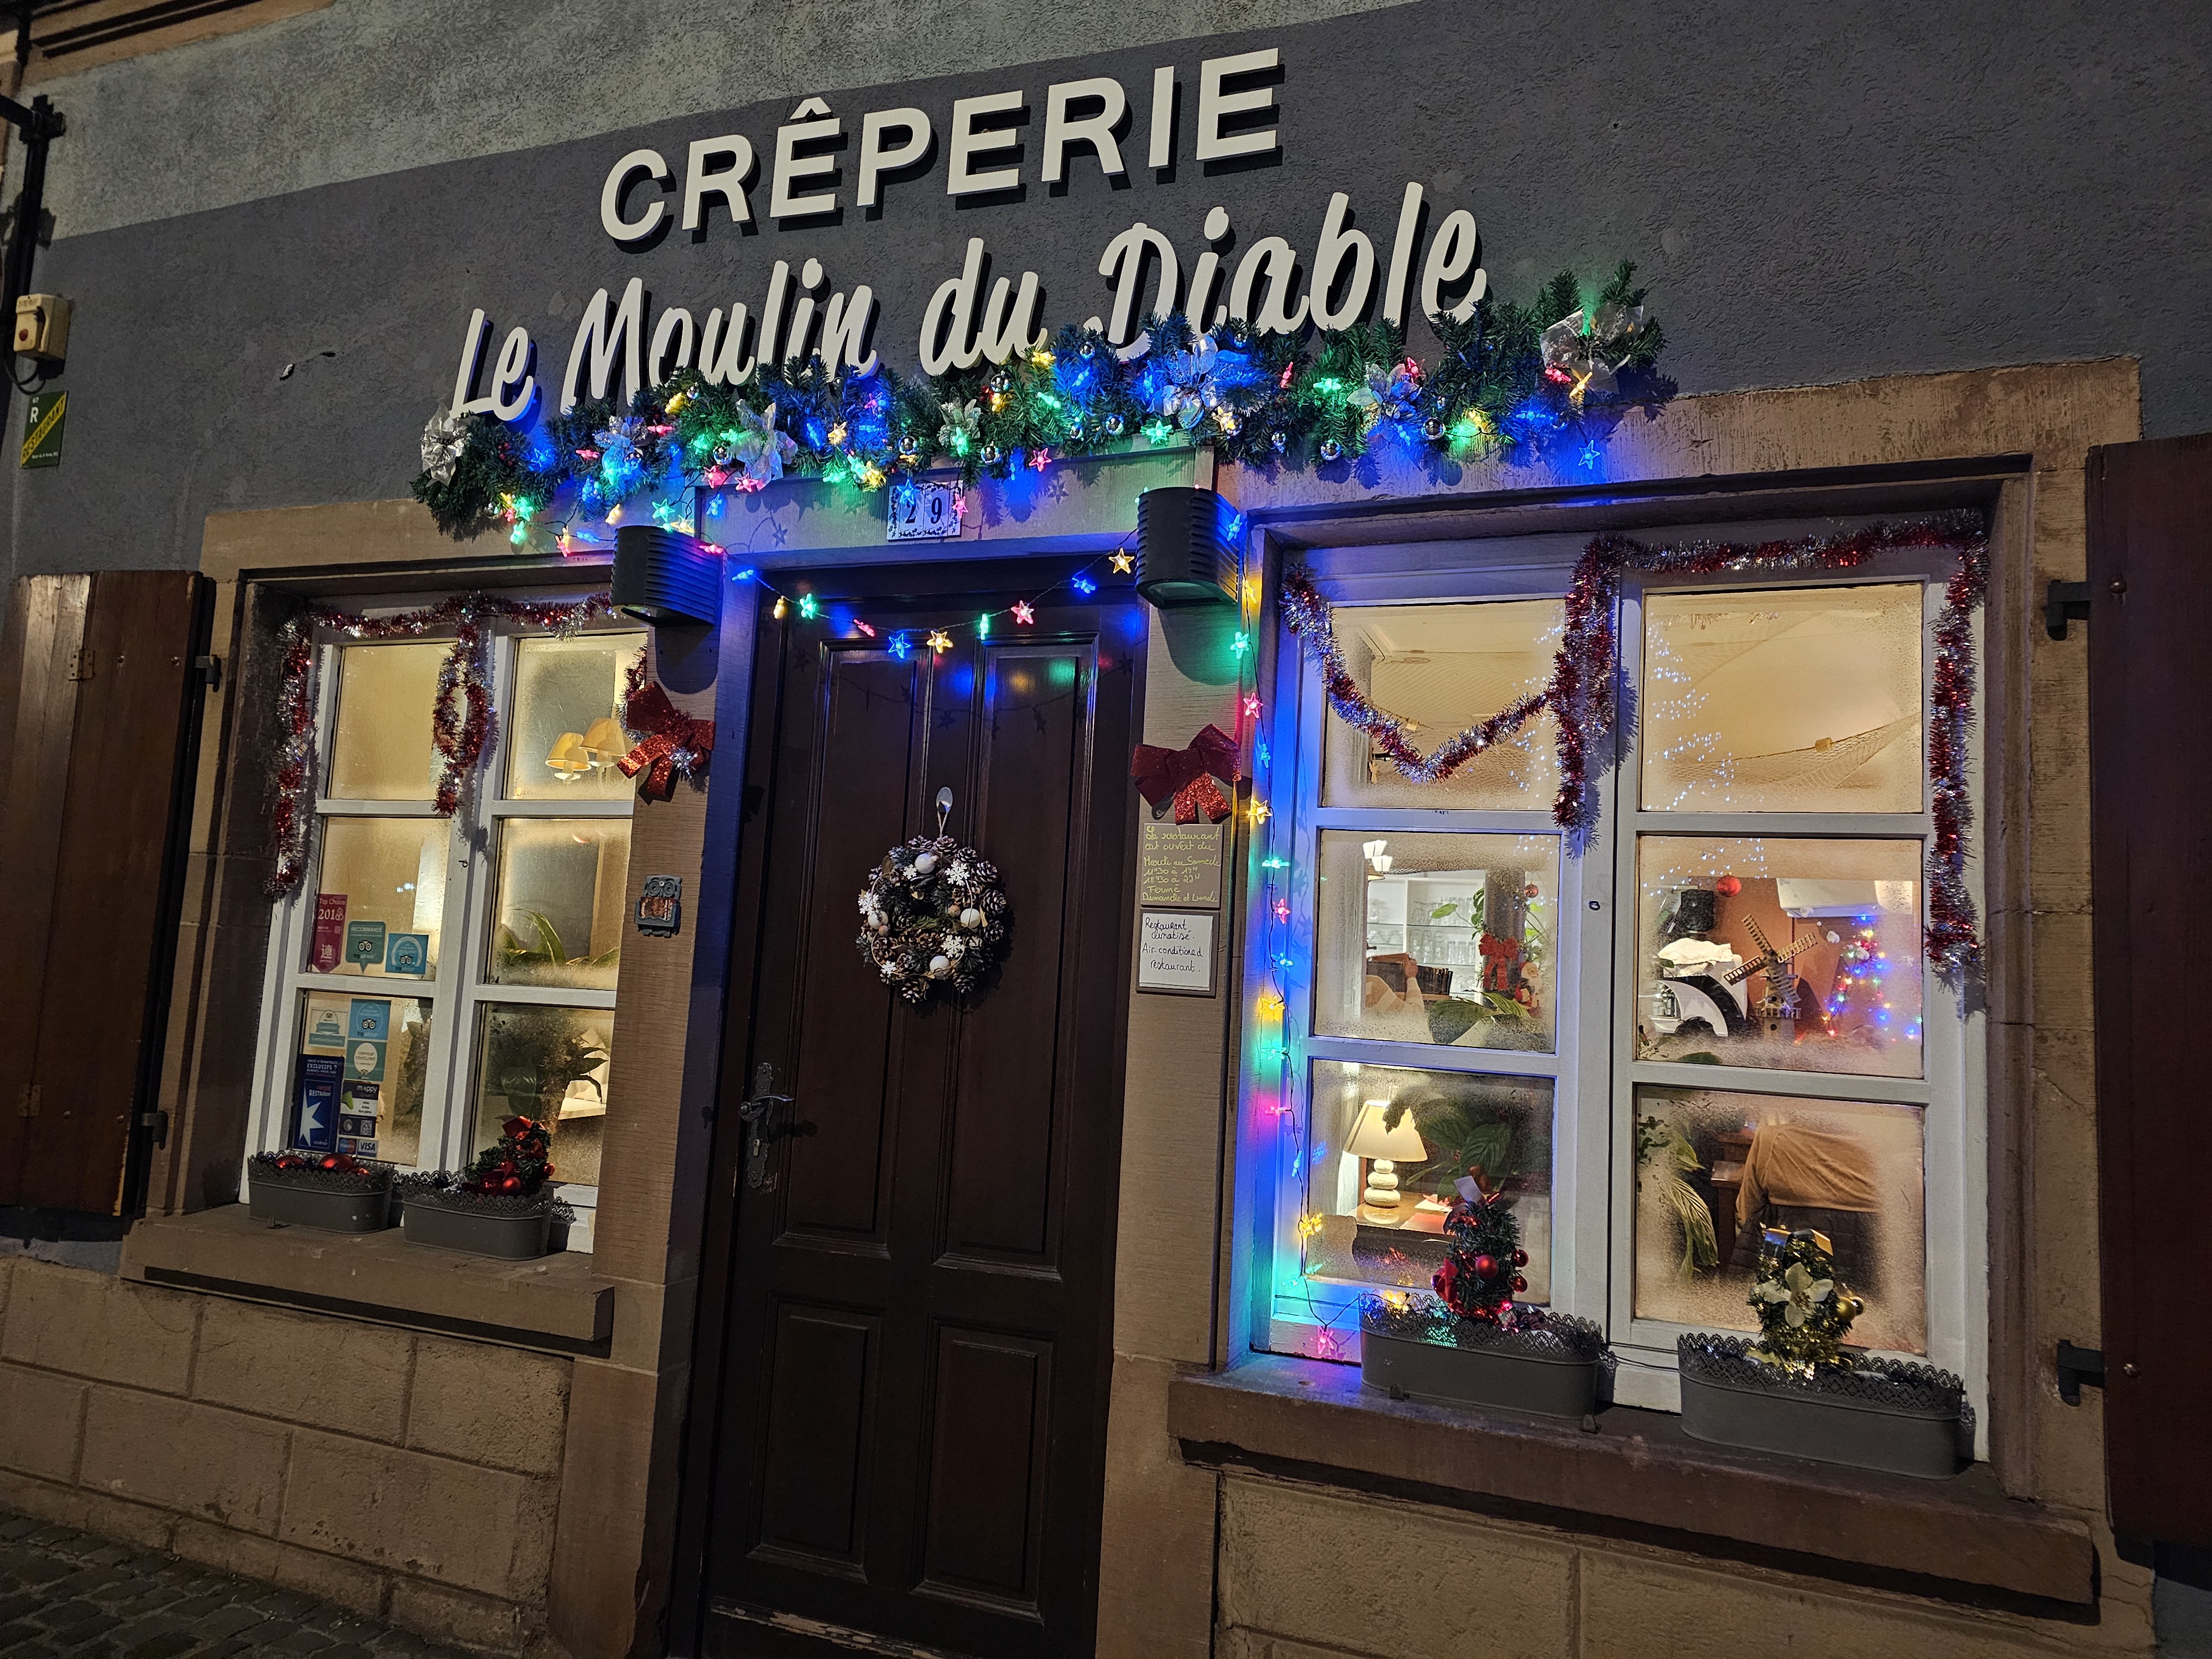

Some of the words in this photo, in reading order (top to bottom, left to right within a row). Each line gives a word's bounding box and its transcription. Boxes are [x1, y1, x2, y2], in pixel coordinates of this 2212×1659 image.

[599, 48, 1279, 242] CRÊPERIE
[449, 308, 535, 421] Le
[560, 258, 878, 415] Moulin
[920, 238, 1047, 377] du
[1084, 181, 1486, 362] Diable
[30, 407, 39, 423] R
[23, 398, 64, 458] RESTAURANT
[1145, 826, 1158, 840] Le
[1161, 827, 1220, 841] restaurant
[1163, 840, 1194, 851] ouvert
[1197, 842, 1216, 851] du
[1144, 855, 1171, 866] Mardi
[1187, 855, 1221, 866] Samedi
[1147, 884, 1181, 893] Fermé
[1142, 892, 1182, 902] Dimanche
[1192, 890, 1218, 902] Lundi
[317, 907, 343, 921] 2018
[1145, 917, 1187, 931] Restaurant
[361, 1142, 376, 1152] VISA
